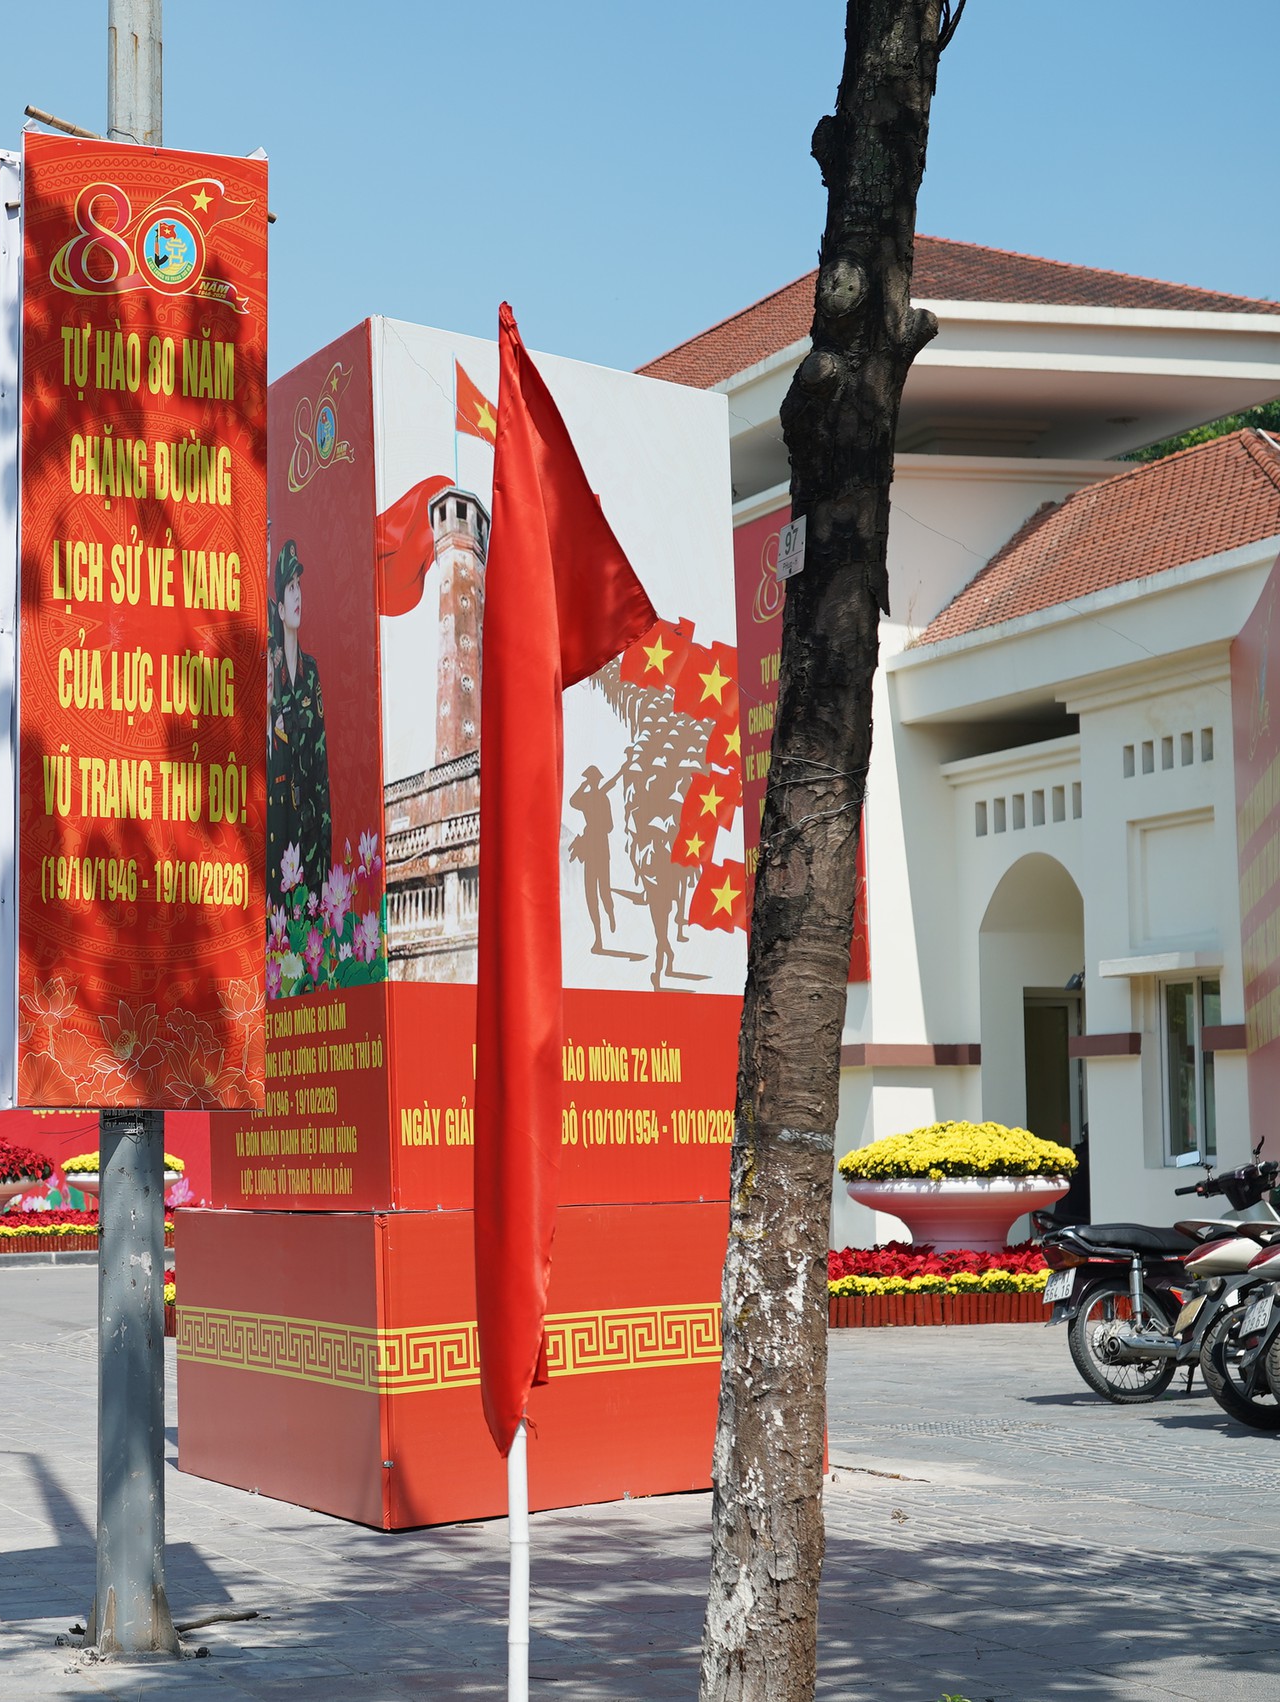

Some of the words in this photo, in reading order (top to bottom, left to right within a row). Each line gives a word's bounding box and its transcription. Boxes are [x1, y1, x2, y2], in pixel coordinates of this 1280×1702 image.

[199, 281, 230, 294] NĂM
[61, 321, 91, 400] TỰ
[96, 319, 141, 393] HÀO
[148, 333, 175, 396] 80
[182, 327, 235, 400] NĂM
[70, 424, 147, 510] CHẶNG
[154, 429, 232, 505] ĐƯỜNG
[785, 527, 799, 555] 97
[53, 539, 103, 614] LỊCH
[110, 524, 144, 605] SỬ
[147, 527, 174, 607] VẺ
[181, 549, 241, 612] VANG
[58, 627, 104, 710] CỦA
[111, 646, 153, 726] LỰC
[160, 649, 234, 729] LƯỢNG
[760, 652, 770, 690] TỰ
[748, 700, 774, 739] CHẶNG
[43, 743, 71, 817] VŨ
[78, 757, 152, 821] TRANG
[159, 741, 202, 823] THỦ
[208, 751, 248, 824] ĐÔ!
[745, 744, 755, 783] VẺ
[756, 749, 771, 780] VAN
[41, 855, 137, 905] (19/10/1946
[142, 879, 149, 889] -
[154, 860, 249, 911] 19/10/2026)
[274, 1006, 293, 1039] CHÀO
[294, 1003, 316, 1035] MỪNG
[317, 1005, 327, 1032] 80
[328, 998, 347, 1031] NĂM
[278, 1048, 292, 1083] LỰC
[293, 1046, 317, 1081] LƯỢNG
[317, 1041, 328, 1073] VŨ
[329, 1043, 354, 1071] TRANG
[355, 1032, 370, 1070] THỦ
[371, 1033, 383, 1068] ĐÔ
[562, 1038, 585, 1082] ÀO
[588, 1040, 629, 1082] MỪNG
[631, 1047, 648, 1082] 72
[651, 1041, 682, 1083] NĂM
[295, 1086, 338, 1116] 19/10/2026)
[401, 1100, 440, 1146] NGÀY
[445, 1095, 474, 1146] GIẢI
[562, 1101, 578, 1145] ĐÔ
[582, 1108, 659, 1149] (10/10/1954
[235, 1126, 245, 1157] VÀ
[245, 1126, 259, 1157] ĐÓN
[261, 1125, 279, 1162] NHẬN
[280, 1128, 299, 1155] DANH
[300, 1122, 317, 1160] HIỆU
[319, 1127, 334, 1154] ANH
[336, 1120, 357, 1153] HÙNG
[240, 1168, 253, 1201] LỰC
[254, 1167, 276, 1201] LƯỢNG
[277, 1163, 286, 1194] VŨ
[287, 1168, 310, 1194] TRANG
[312, 1162, 332, 1194] NHÂN
[334, 1162, 353, 1194] DÂN!
